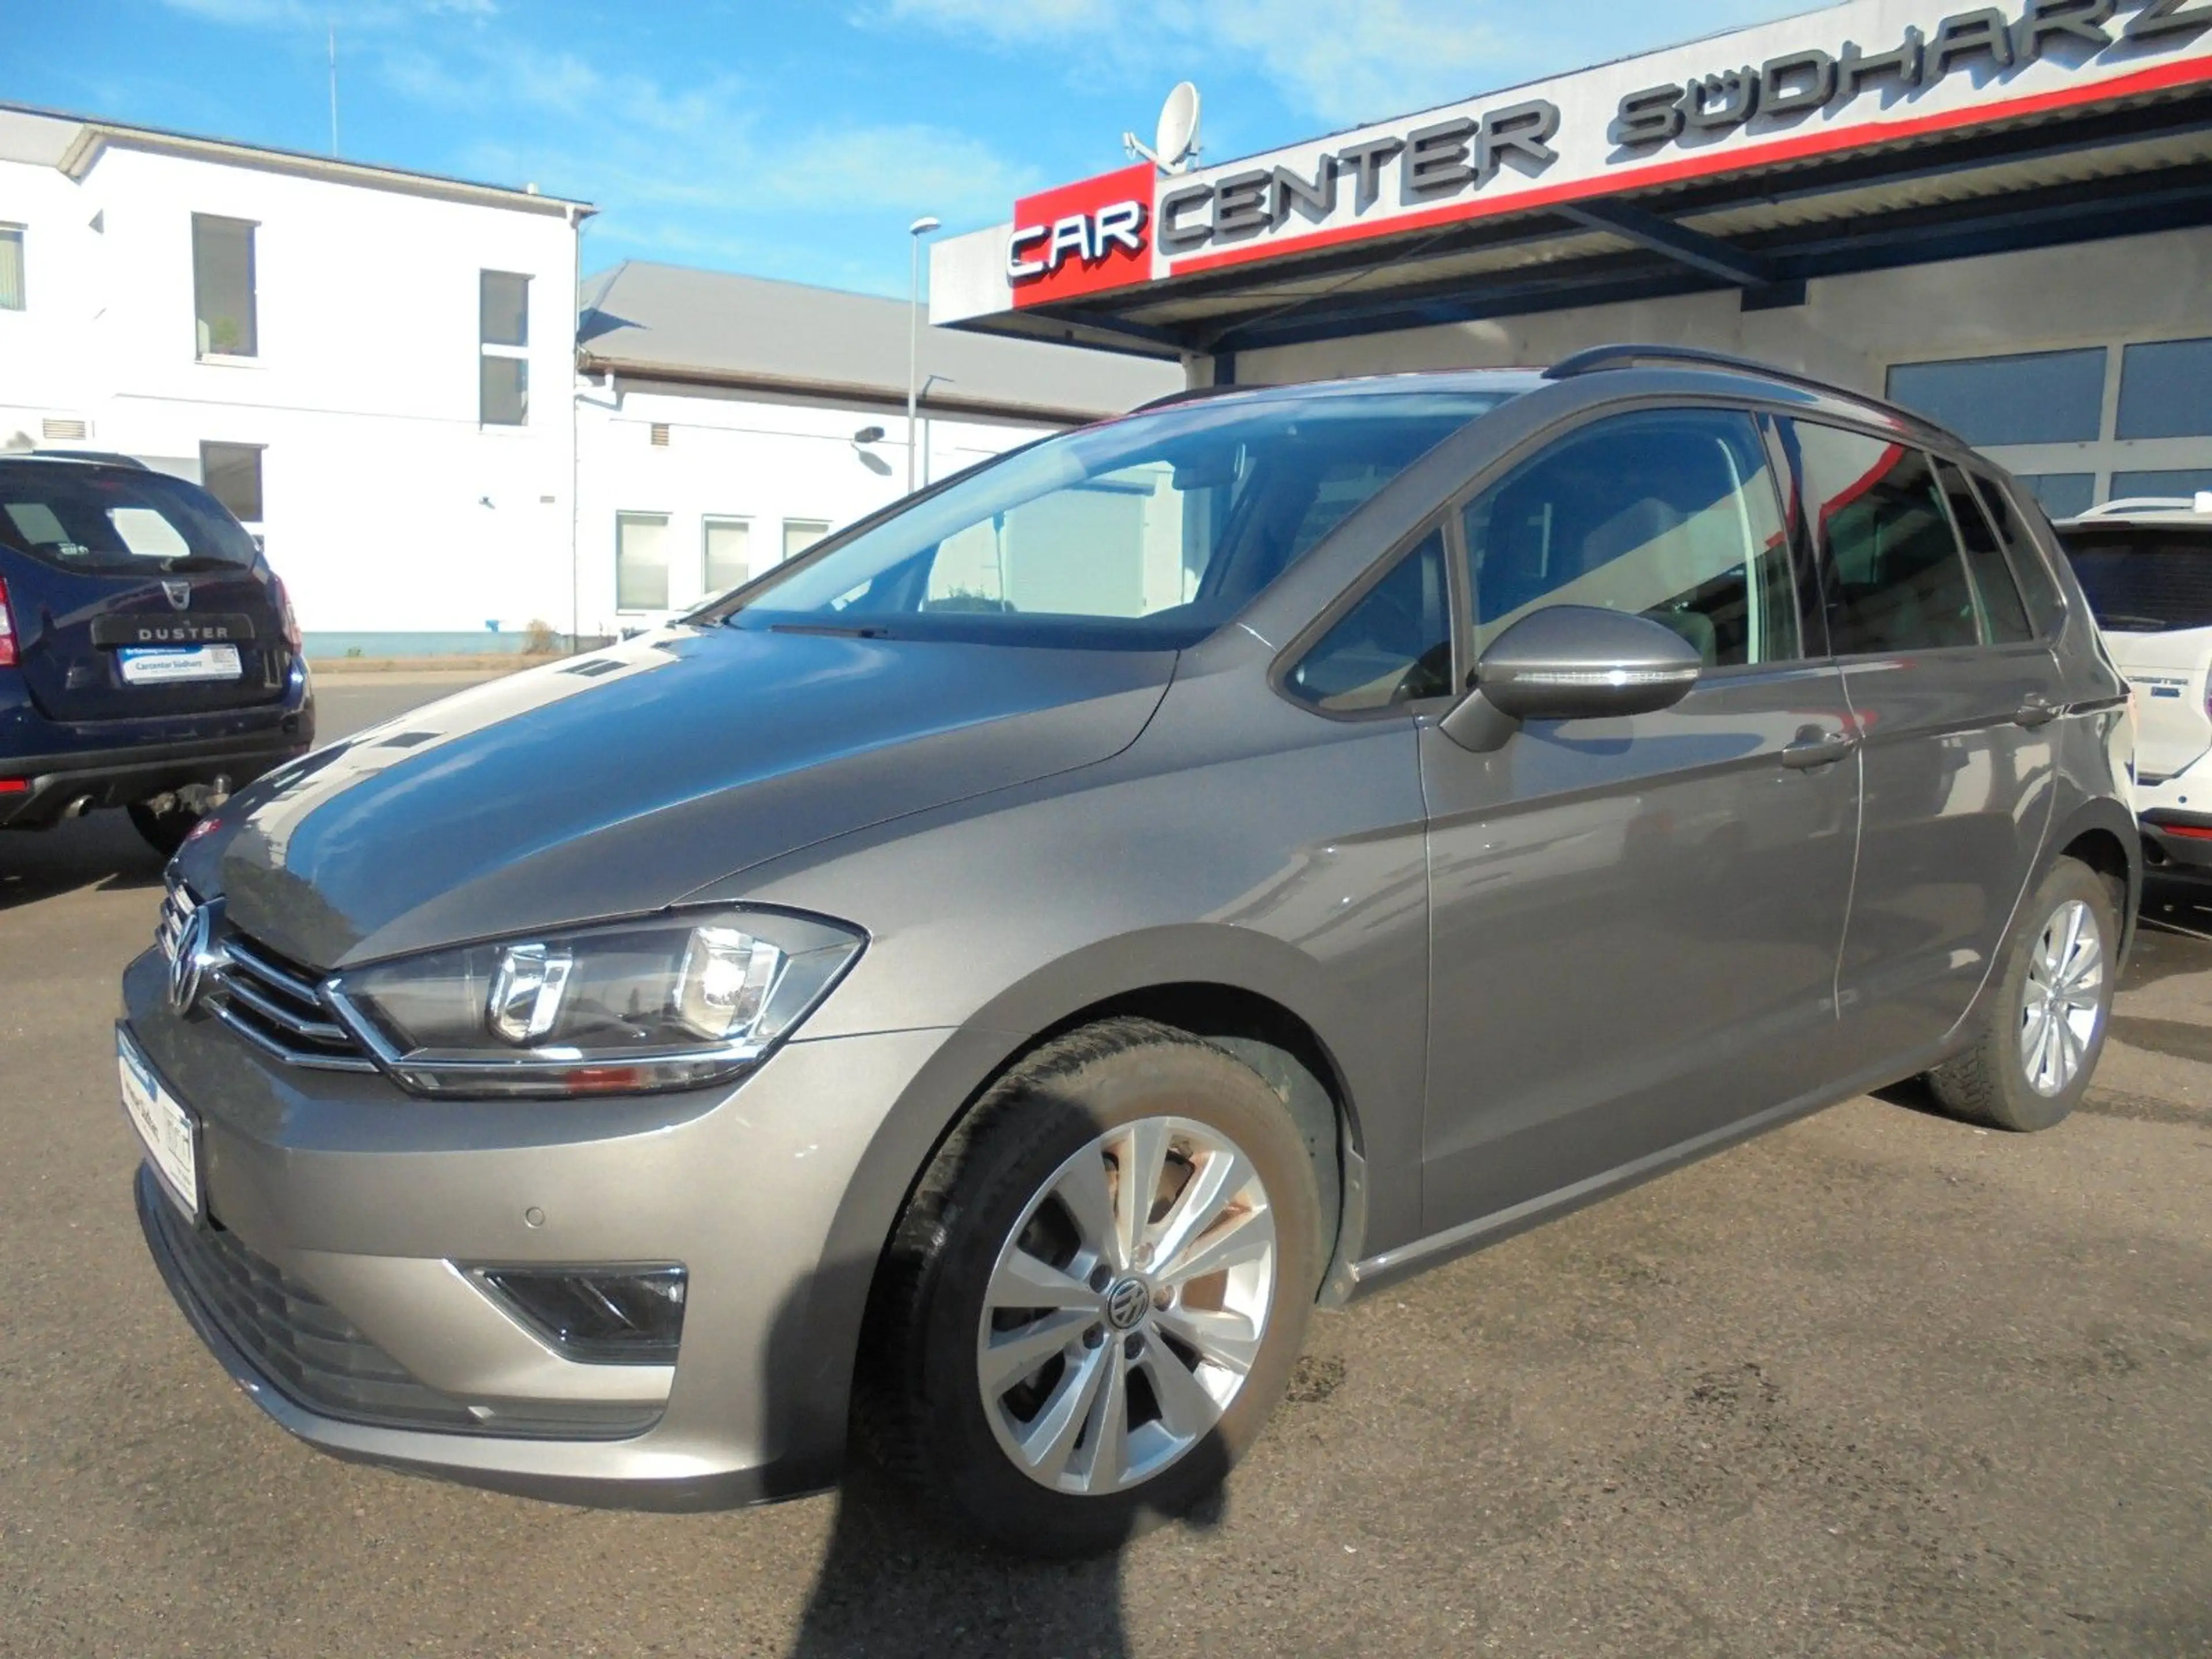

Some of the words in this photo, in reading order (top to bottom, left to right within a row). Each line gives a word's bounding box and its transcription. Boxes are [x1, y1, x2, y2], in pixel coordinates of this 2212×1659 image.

[1006, 199, 1146, 285] CAR
[1160, 99, 1559, 243] CENTER
[139, 627, 228, 640] DUSTER
